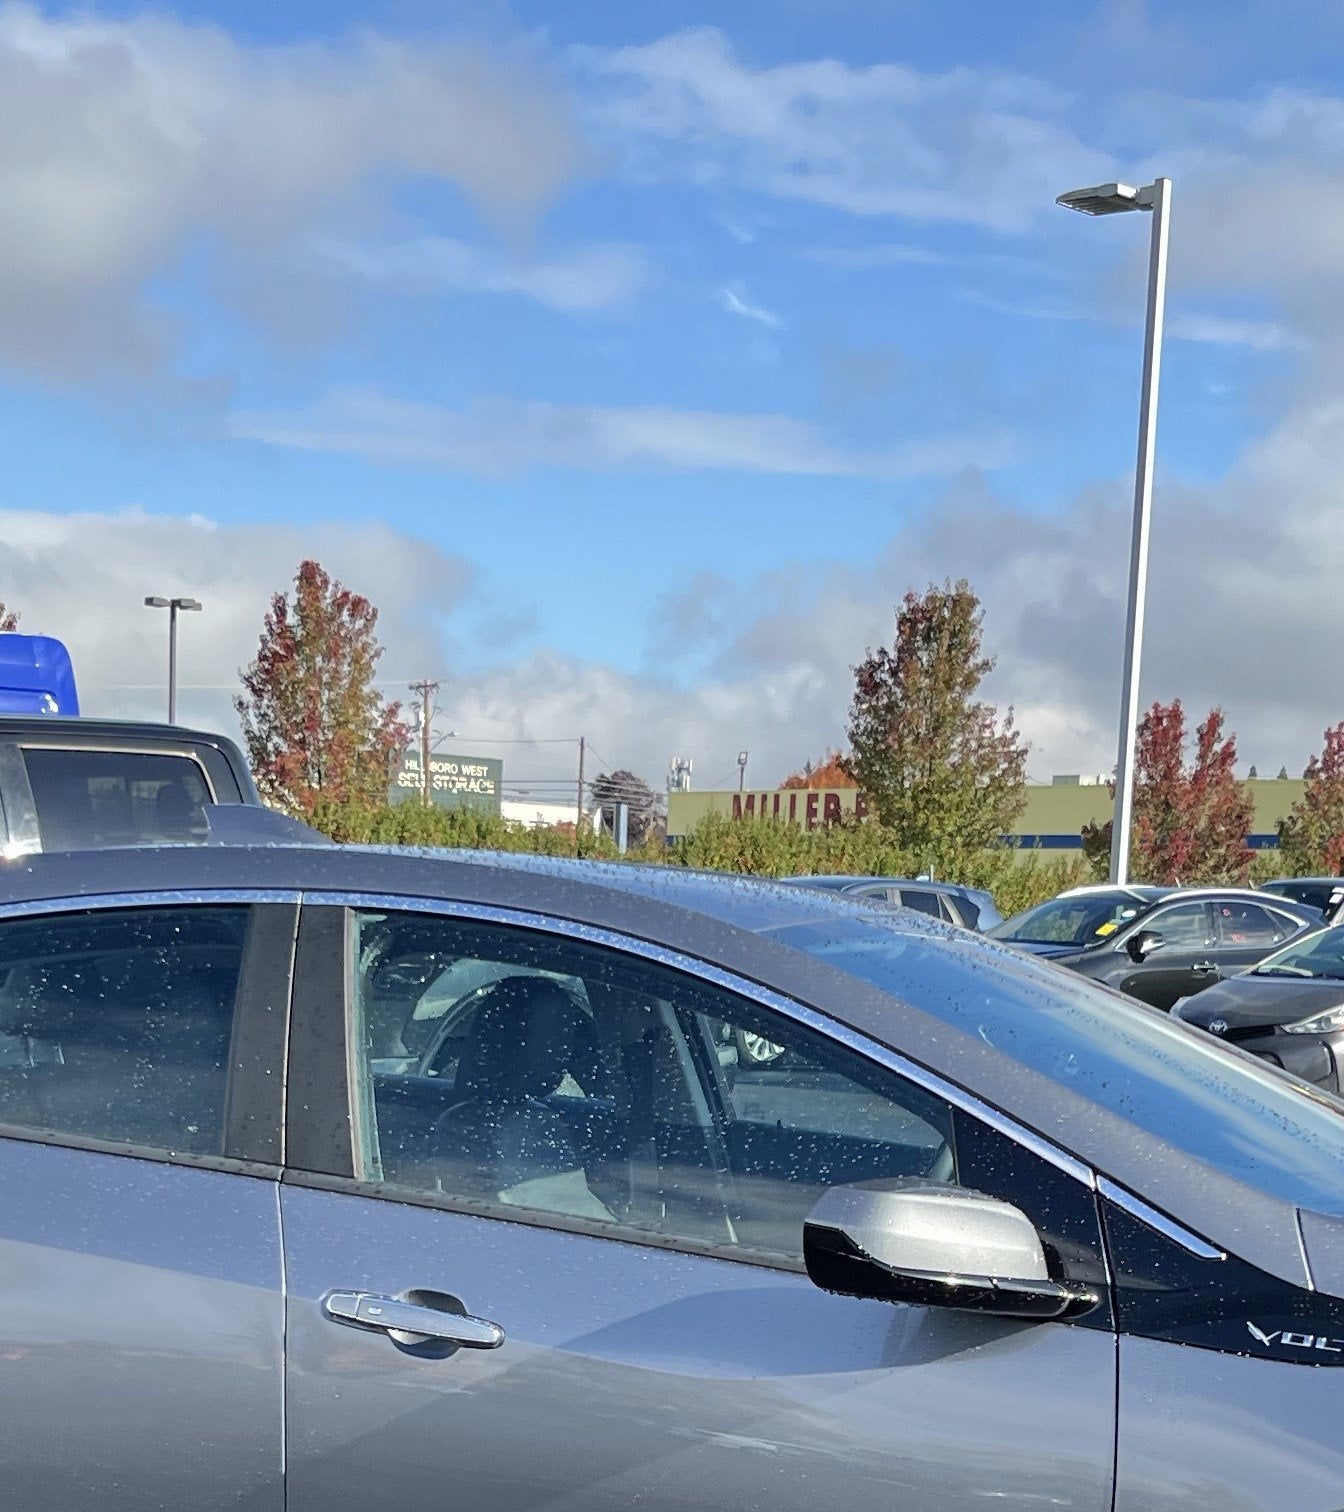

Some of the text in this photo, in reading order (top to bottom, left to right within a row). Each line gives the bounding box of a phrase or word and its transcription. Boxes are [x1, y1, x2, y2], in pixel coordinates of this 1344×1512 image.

[405, 759, 489, 777] HILBORO WEST
[433, 774, 495, 795] STORAGE
